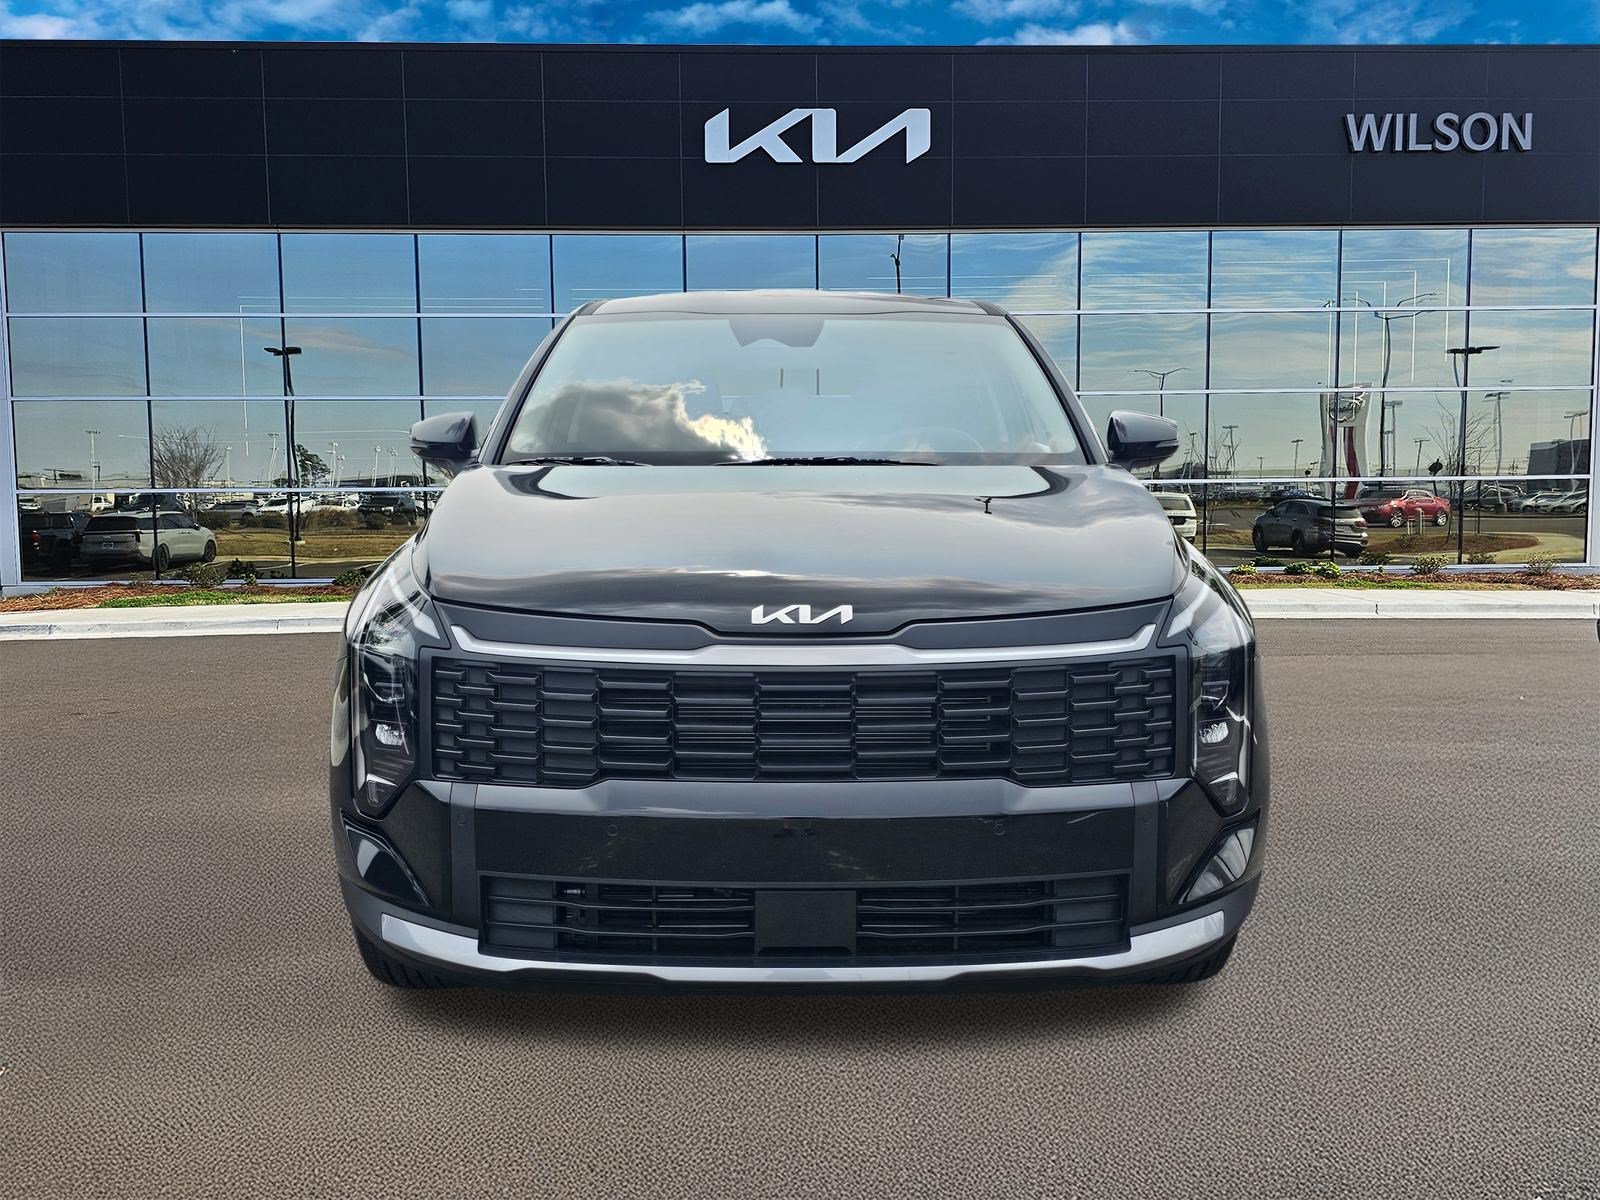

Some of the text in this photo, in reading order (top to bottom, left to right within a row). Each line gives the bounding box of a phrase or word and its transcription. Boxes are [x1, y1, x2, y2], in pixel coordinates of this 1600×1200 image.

[704, 107, 932, 165] KIA
[1345, 112, 1534, 152] WILSON
[751, 604, 853, 625] KIA
